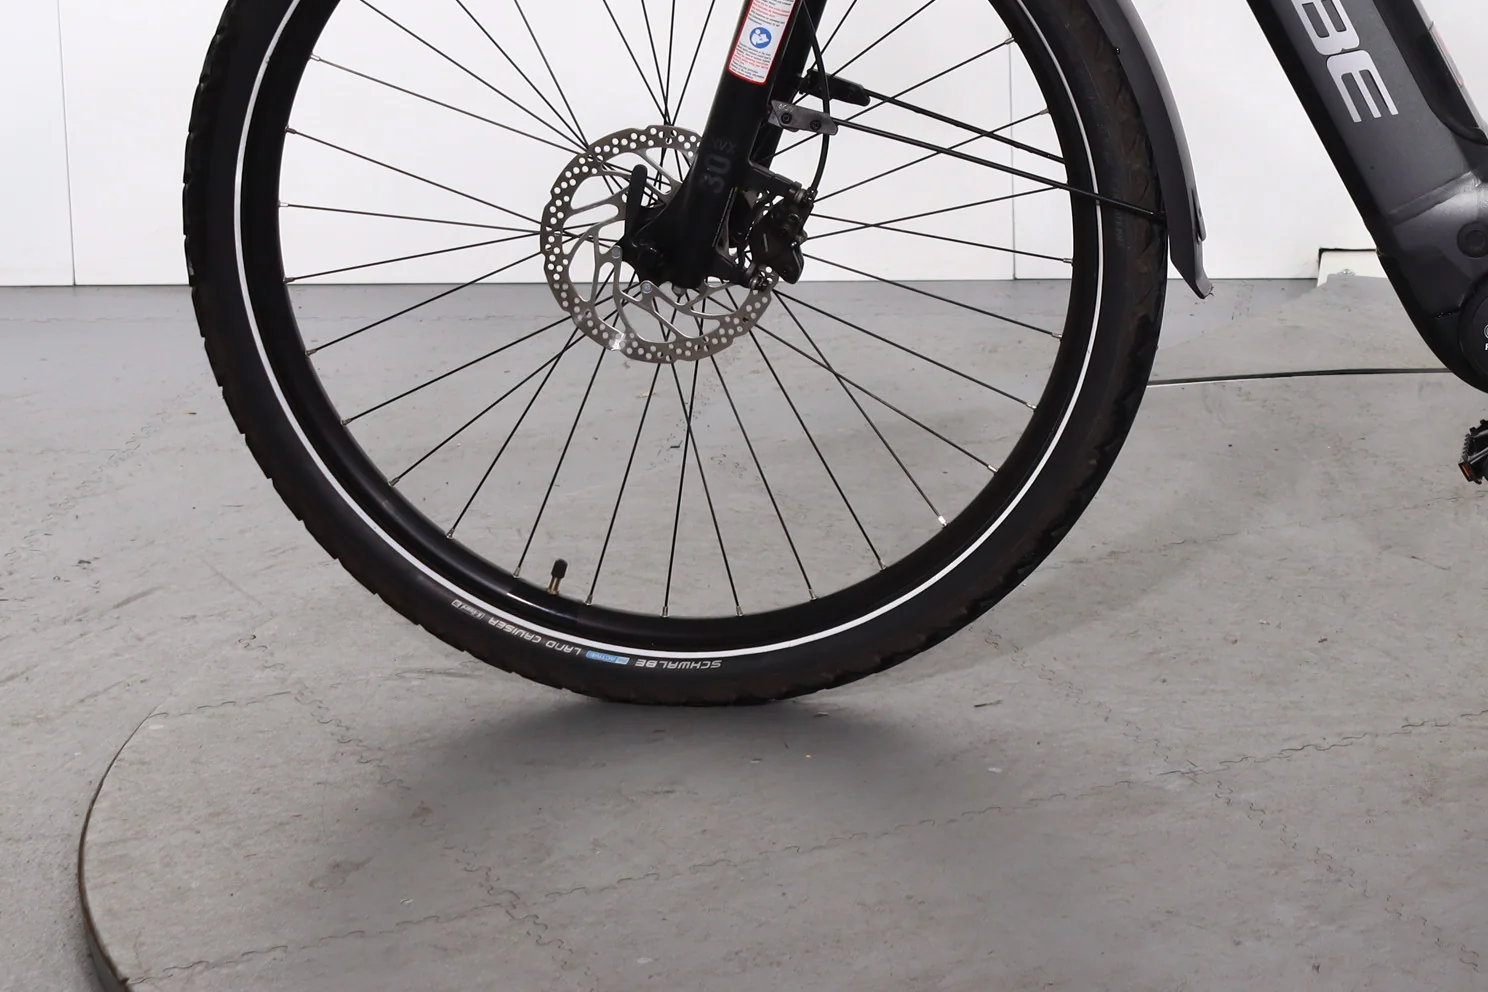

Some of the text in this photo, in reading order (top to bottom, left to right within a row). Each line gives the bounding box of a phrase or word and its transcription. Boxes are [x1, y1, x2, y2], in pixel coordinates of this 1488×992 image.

[488, 617, 542, 645] CRUISER
[545, 640, 582, 655] LAND
[635, 659, 723, 670] SCHWALBE
